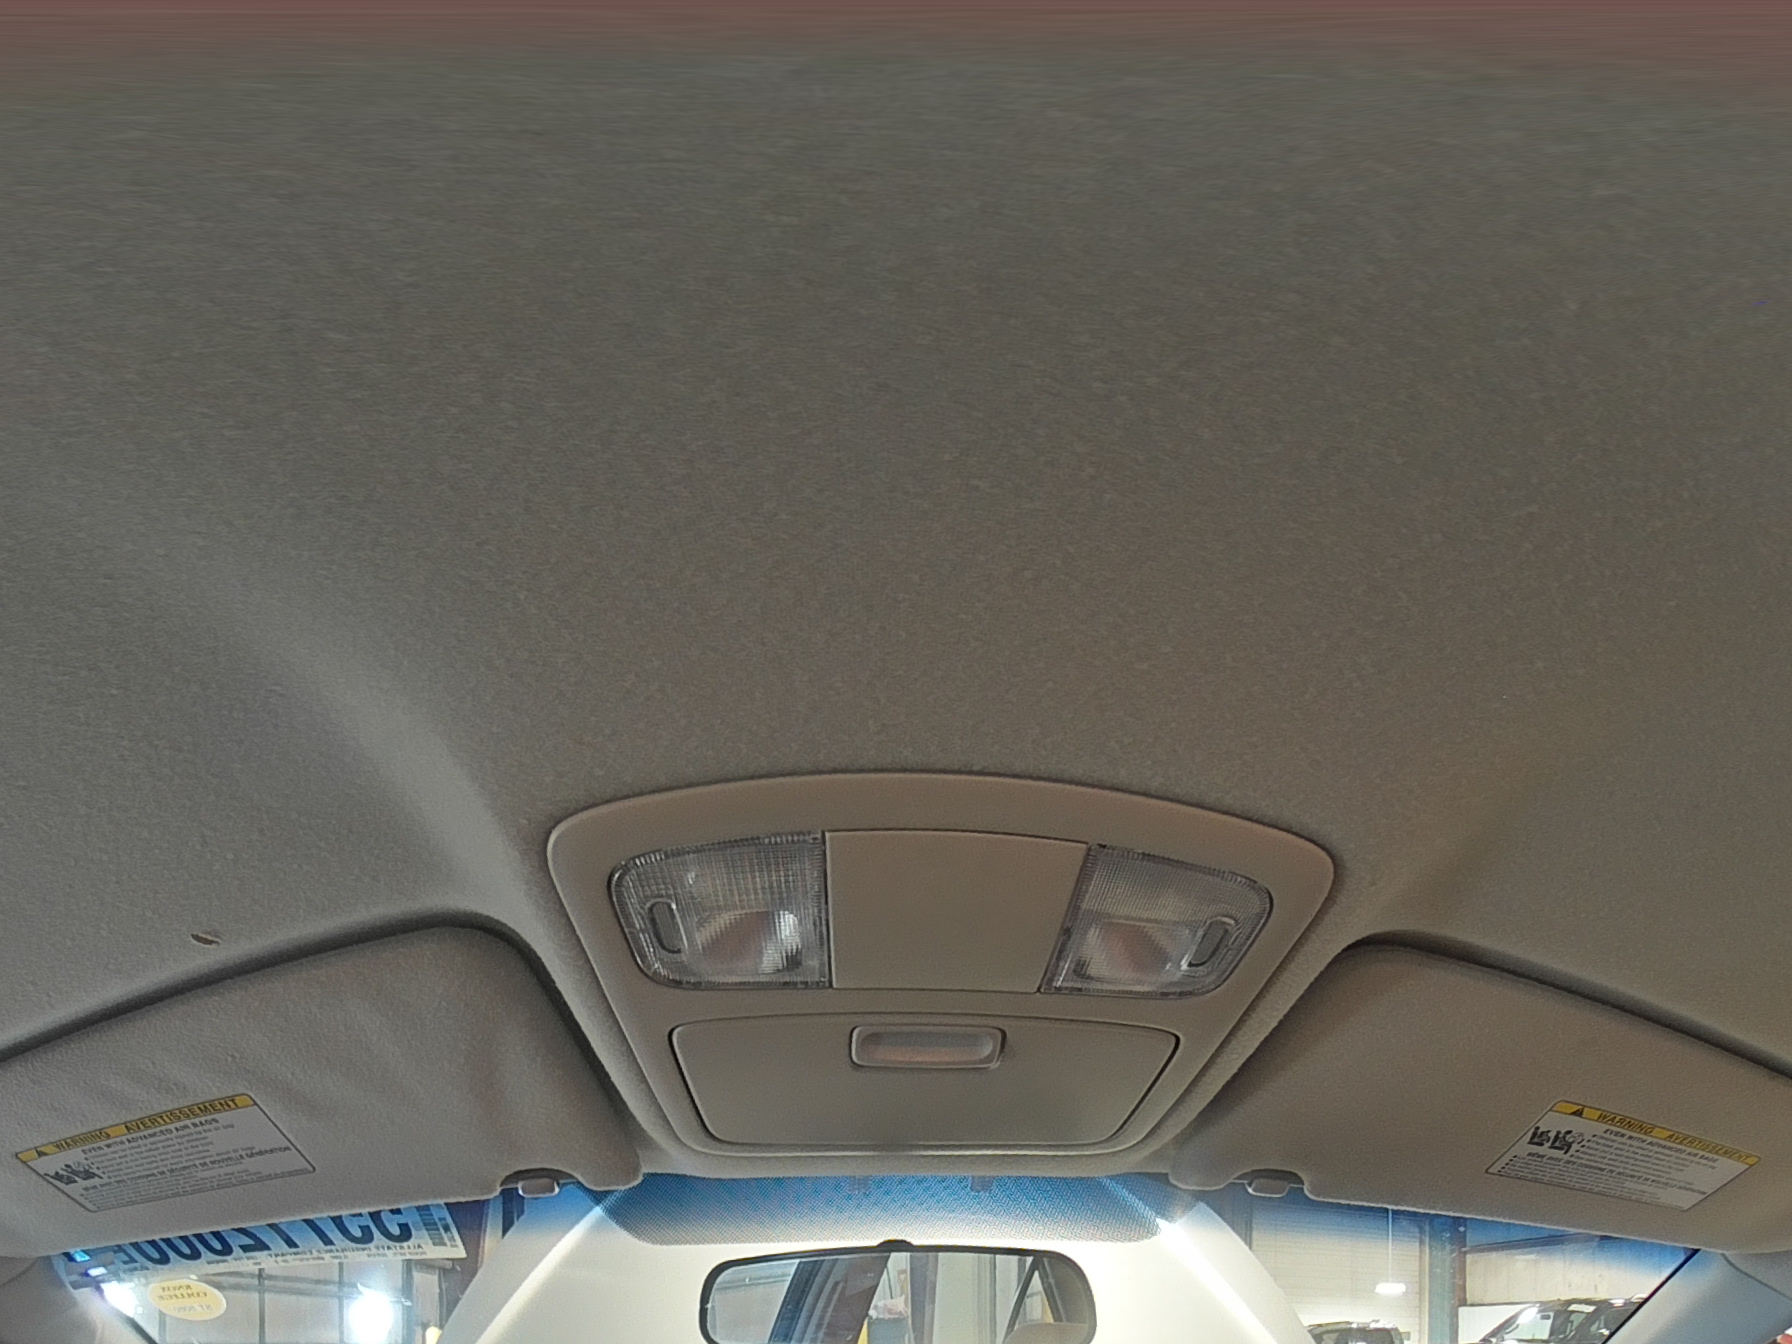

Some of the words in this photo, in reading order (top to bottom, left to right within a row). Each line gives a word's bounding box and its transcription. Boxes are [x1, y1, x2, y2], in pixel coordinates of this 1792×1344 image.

[53, 1130, 111, 1152] WARNING
[124, 1099, 239, 1133] AVERTISSEMENT
[126, 1127, 173, 1144] ADVANCED
[1597, 1112, 1655, 1135] WARNING
[1664, 1133, 1751, 1162] AVERTISSEMENT
